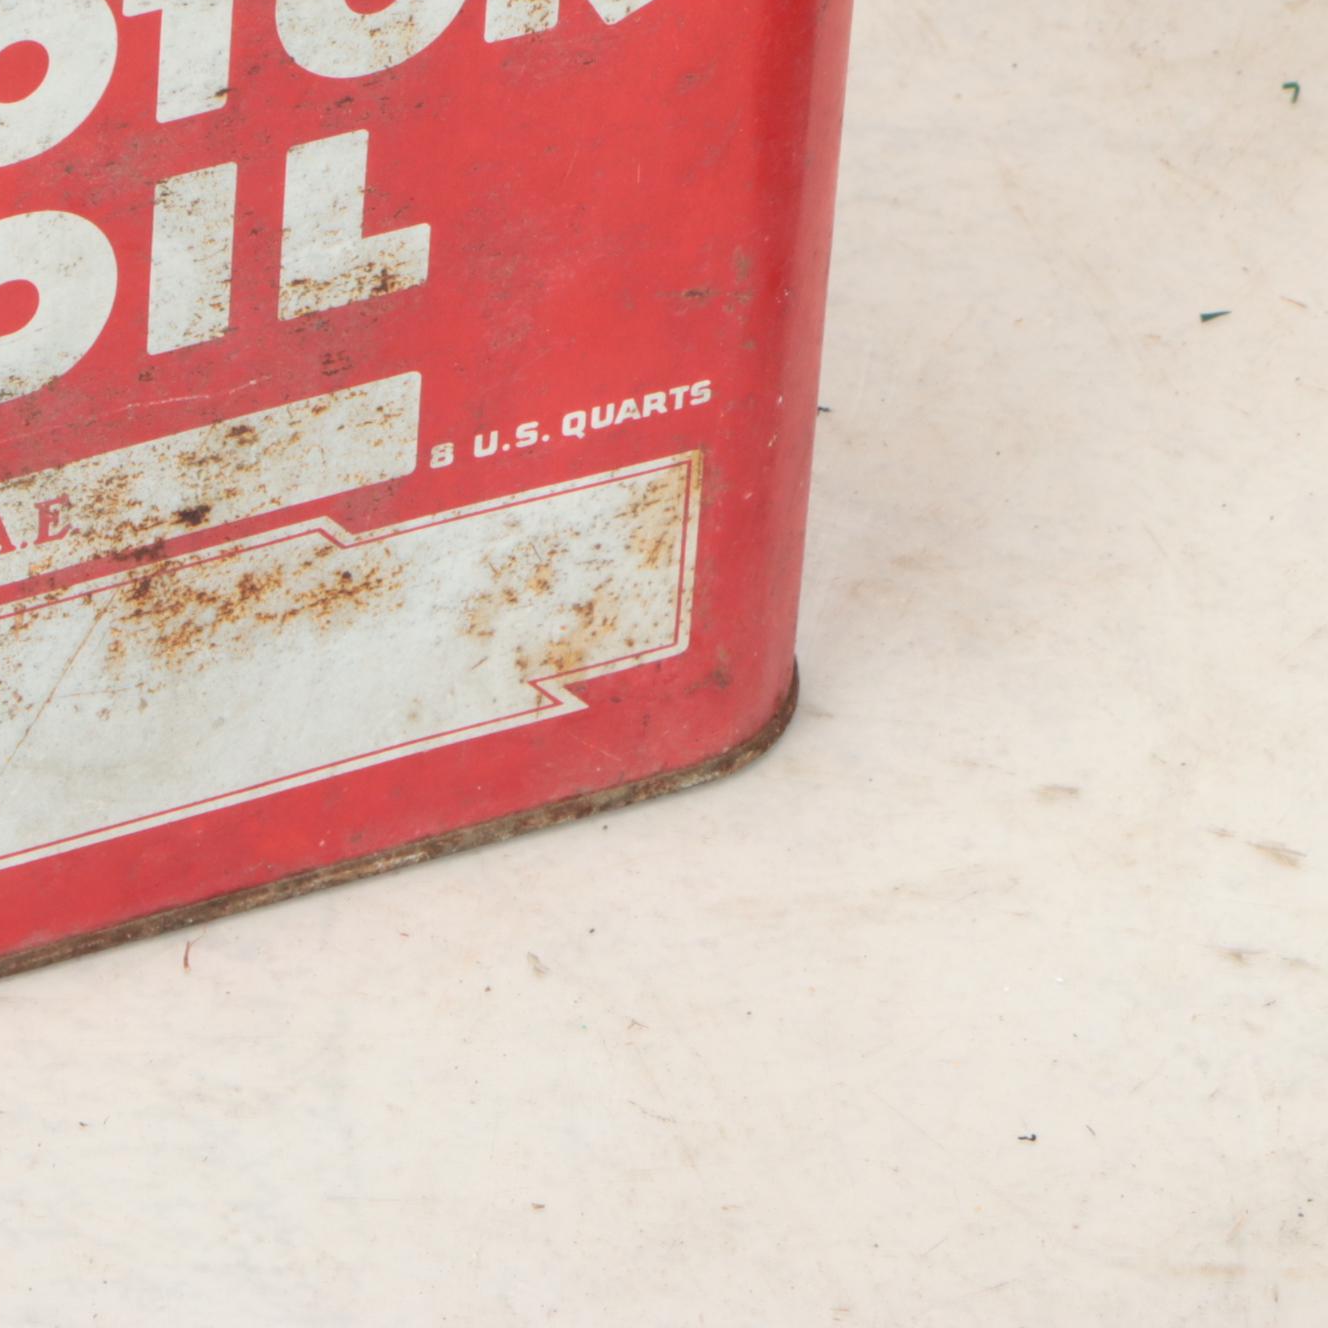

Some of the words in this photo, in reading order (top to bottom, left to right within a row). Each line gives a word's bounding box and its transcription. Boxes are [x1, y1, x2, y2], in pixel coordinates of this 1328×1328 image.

[429, 441, 456, 469] 8
[473, 420, 551, 459] U.S.
[560, 378, 713, 441] QUARTS
